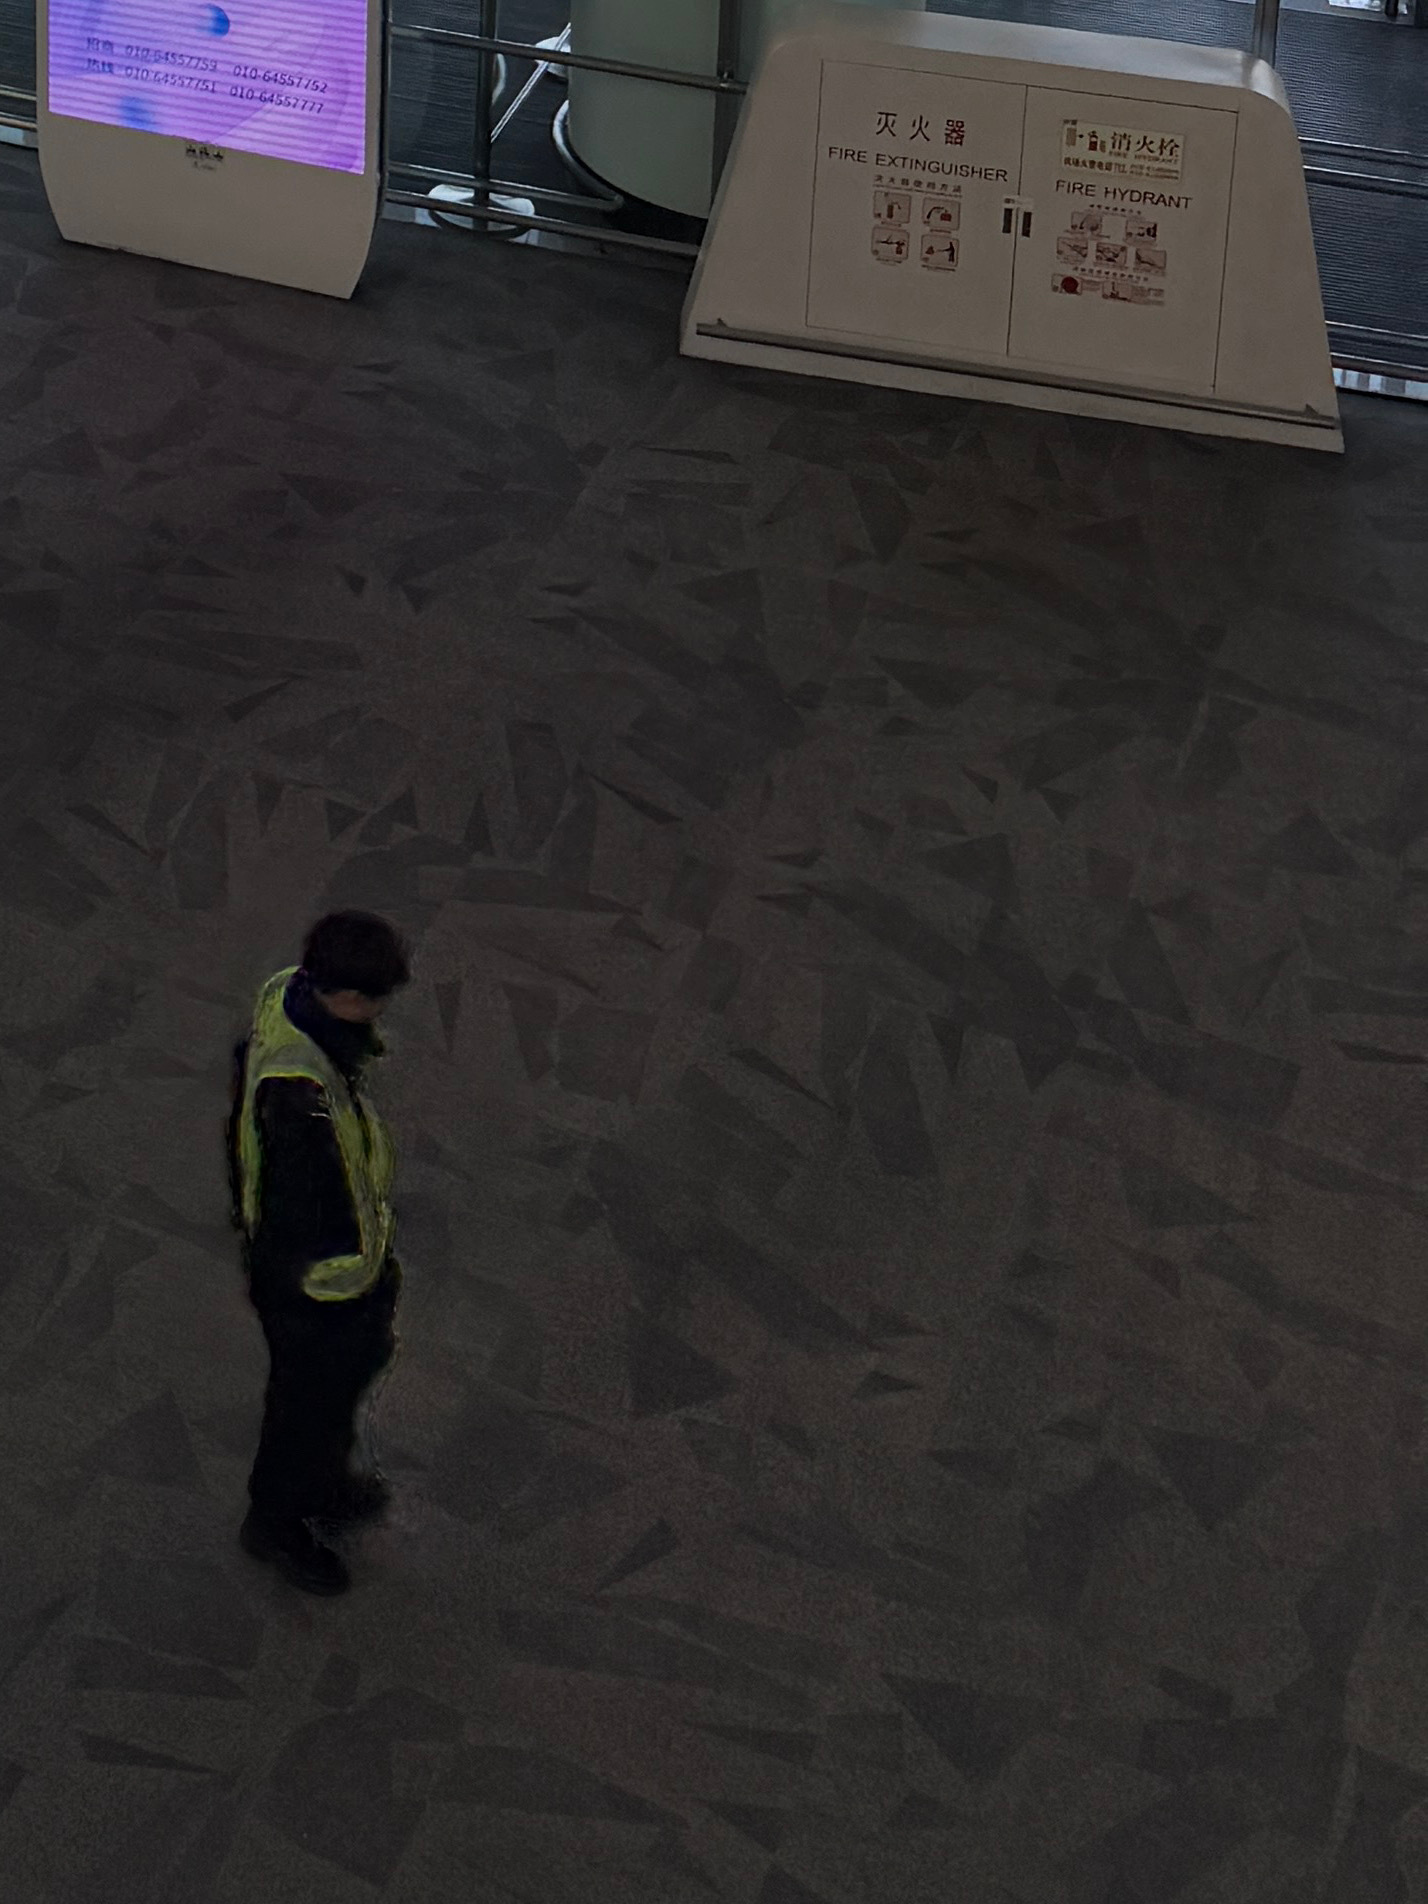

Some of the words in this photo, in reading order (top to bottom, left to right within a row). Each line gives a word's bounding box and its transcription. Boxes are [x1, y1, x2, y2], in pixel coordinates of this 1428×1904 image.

[233, 64, 328, 94] 010-64557752
[876, 111, 966, 147] 灭火器
[1110, 130, 1180, 157] 消火栓
[828, 146, 869, 164] FIRE
[874, 152, 1009, 182] EXTINGUISHER
[1055, 179, 1097, 198] FIRE
[1104, 186, 1193, 210] HYDRANT
